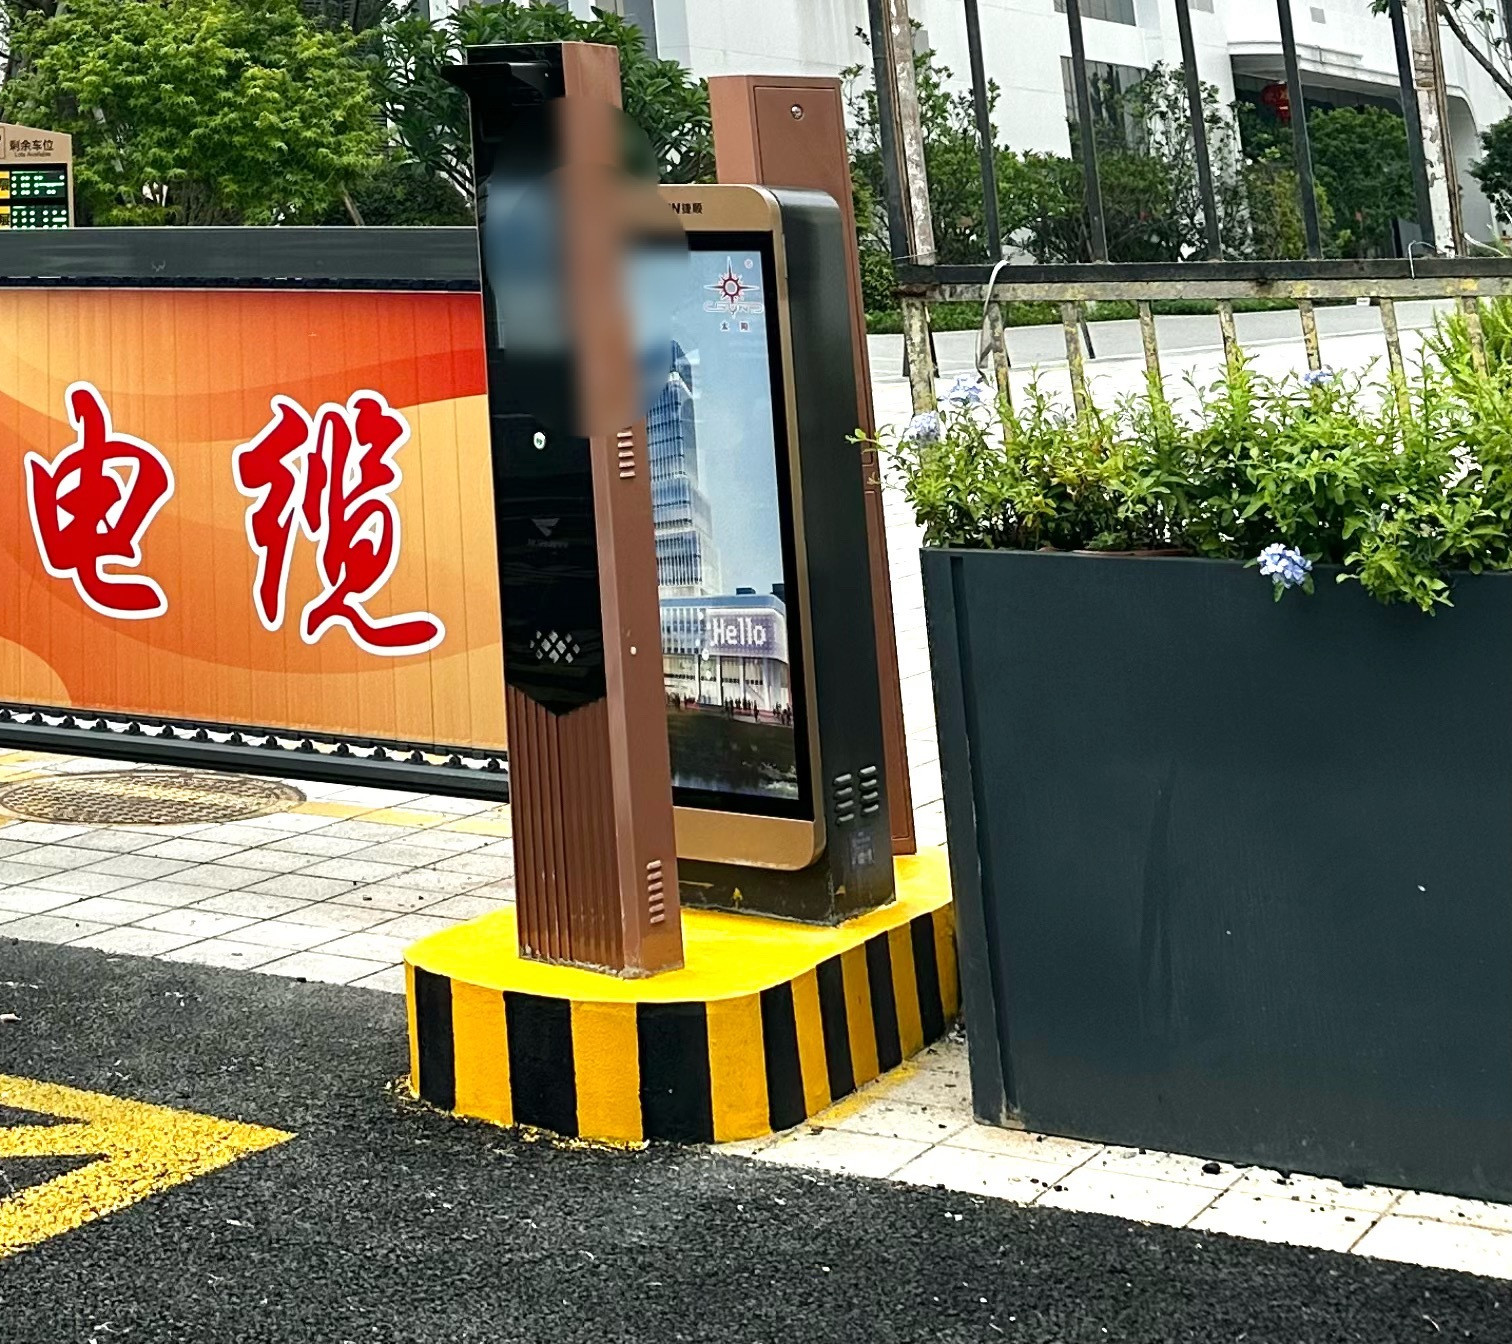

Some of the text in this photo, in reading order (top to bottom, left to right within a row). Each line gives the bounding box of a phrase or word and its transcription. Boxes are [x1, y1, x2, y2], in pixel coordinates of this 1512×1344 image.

[9, 139, 54, 152] 剩余车位
[712, 617, 767, 647] Hello
